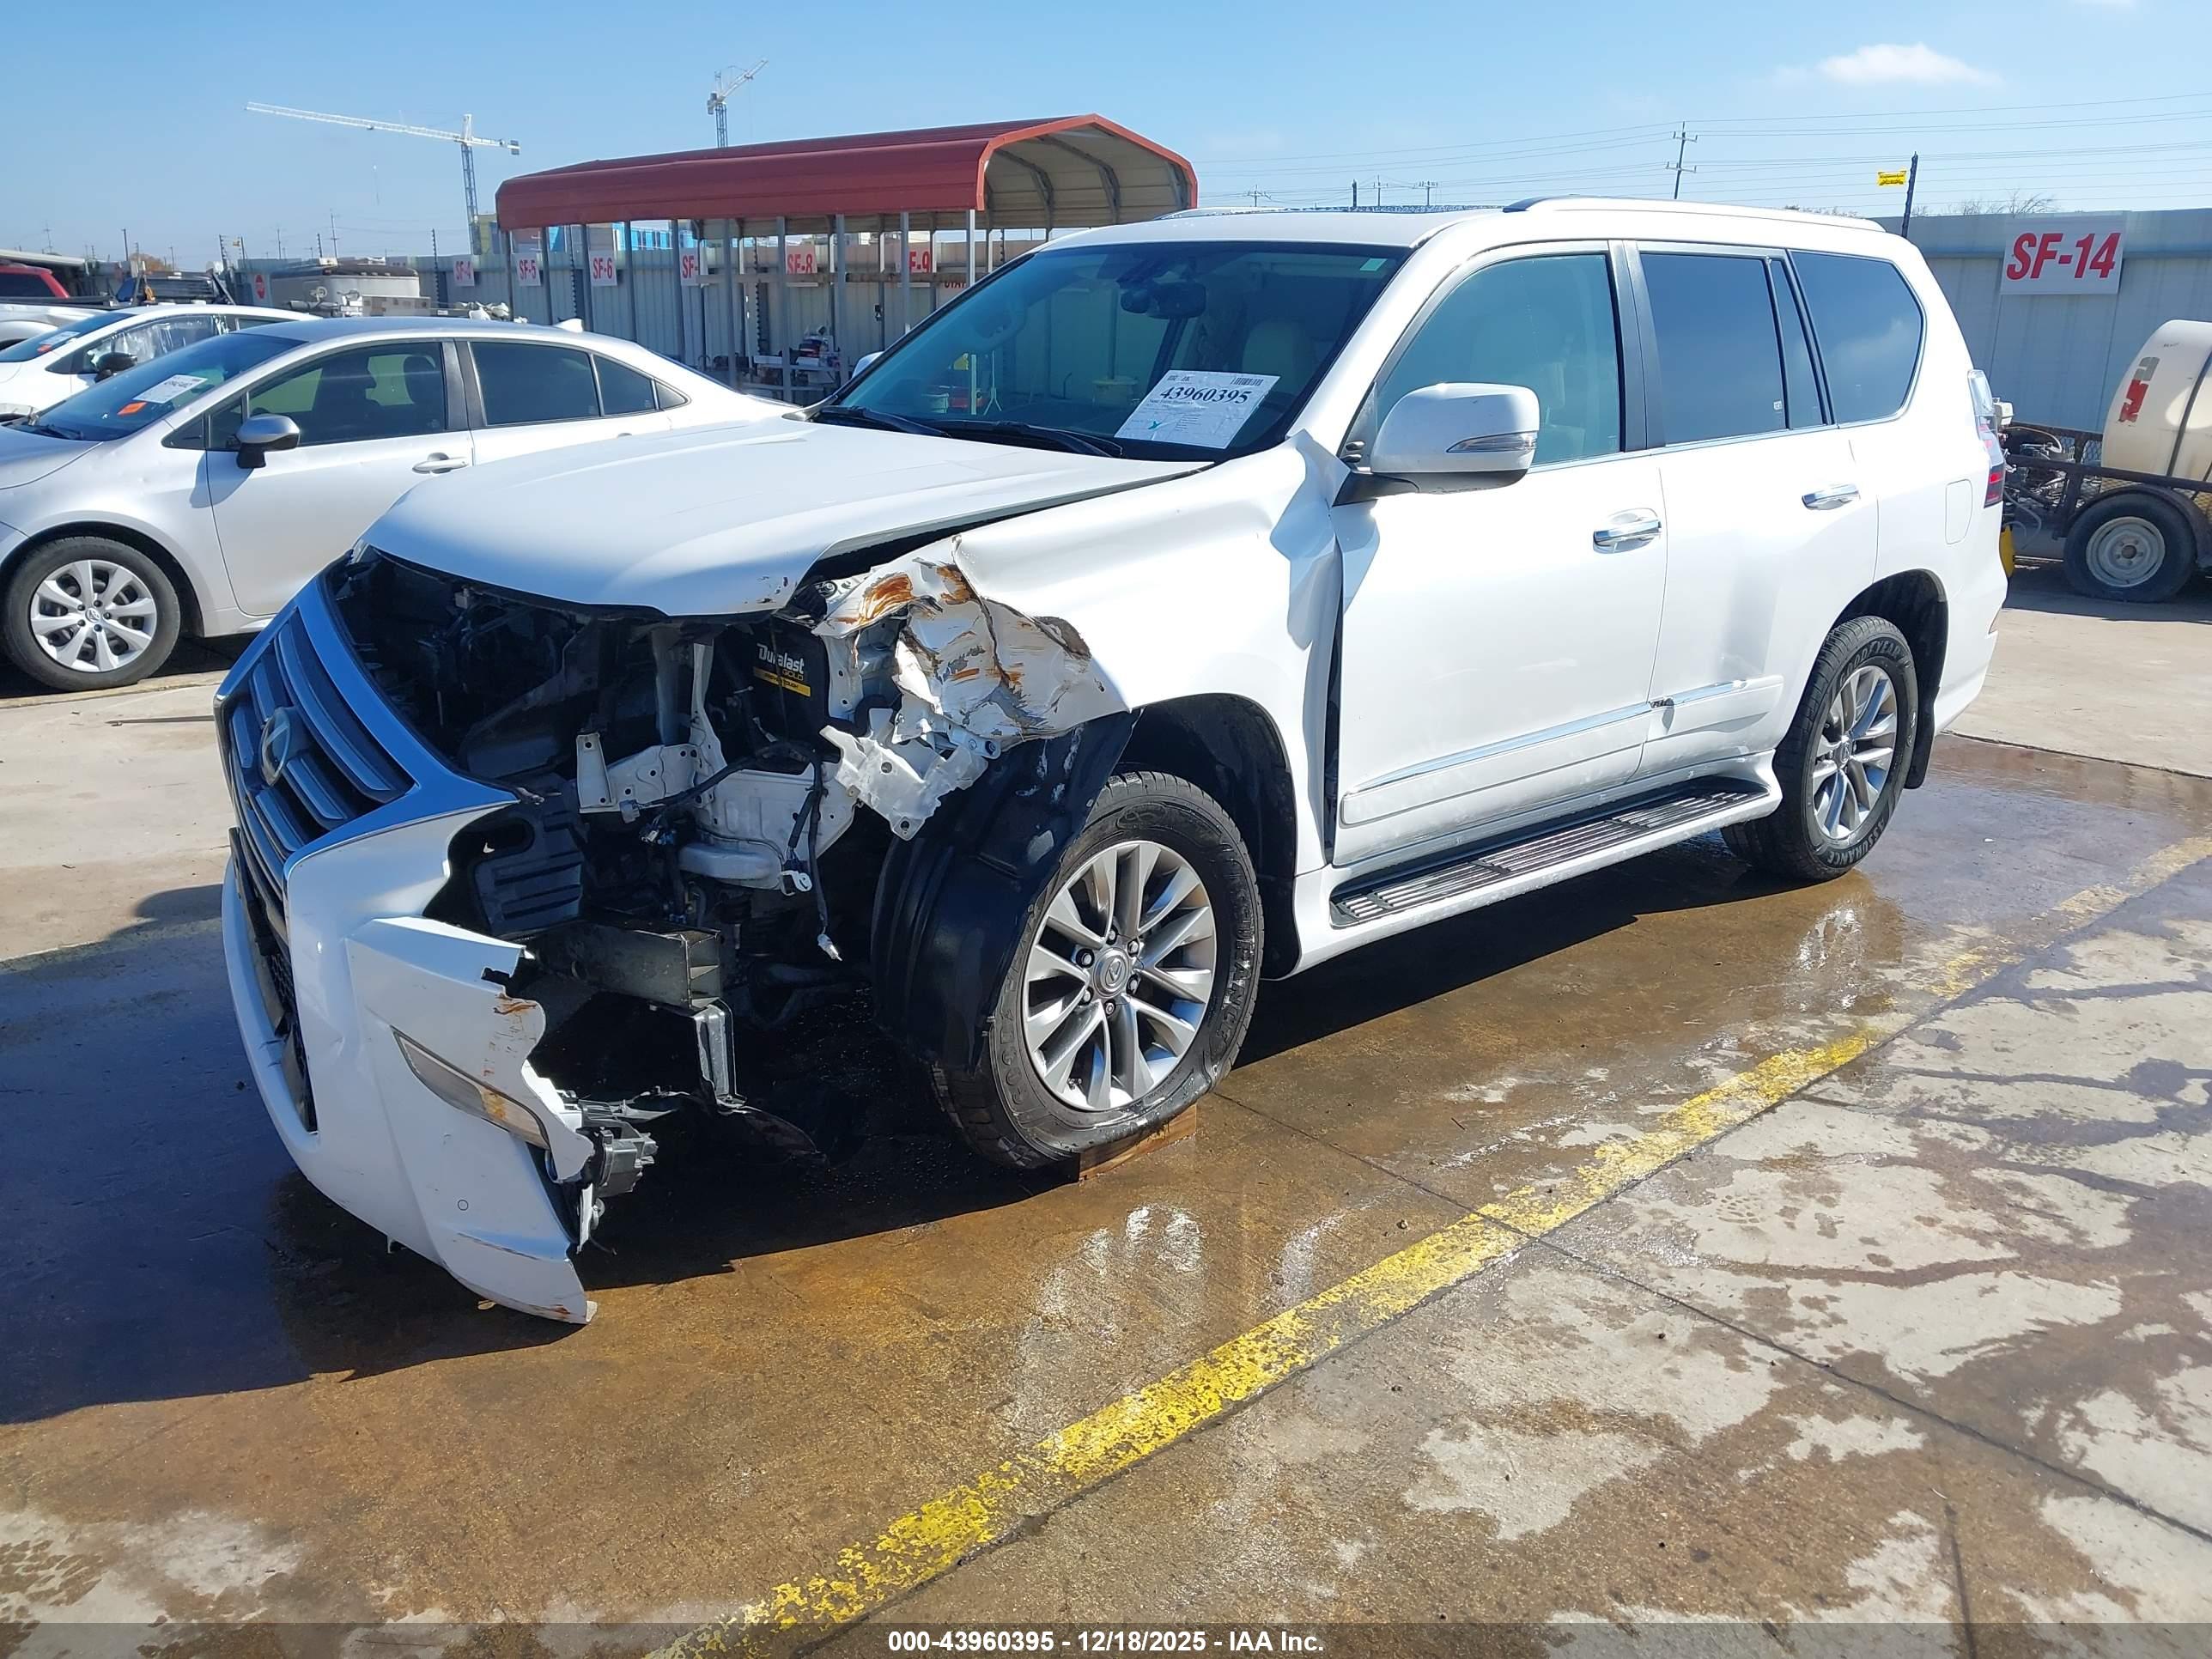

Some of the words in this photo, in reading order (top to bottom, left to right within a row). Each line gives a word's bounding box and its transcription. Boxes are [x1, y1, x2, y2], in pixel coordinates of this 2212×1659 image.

[2006, 232, 2121, 280] SF-14
[455, 260, 471, 280] SF-4
[519, 259, 537, 279] SF-5
[592, 258, 613, 279] SF-6
[682, 254, 699, 279] SF-
[1160, 386, 1252, 404] 43960395
[782, 668, 804, 681] GOLD
